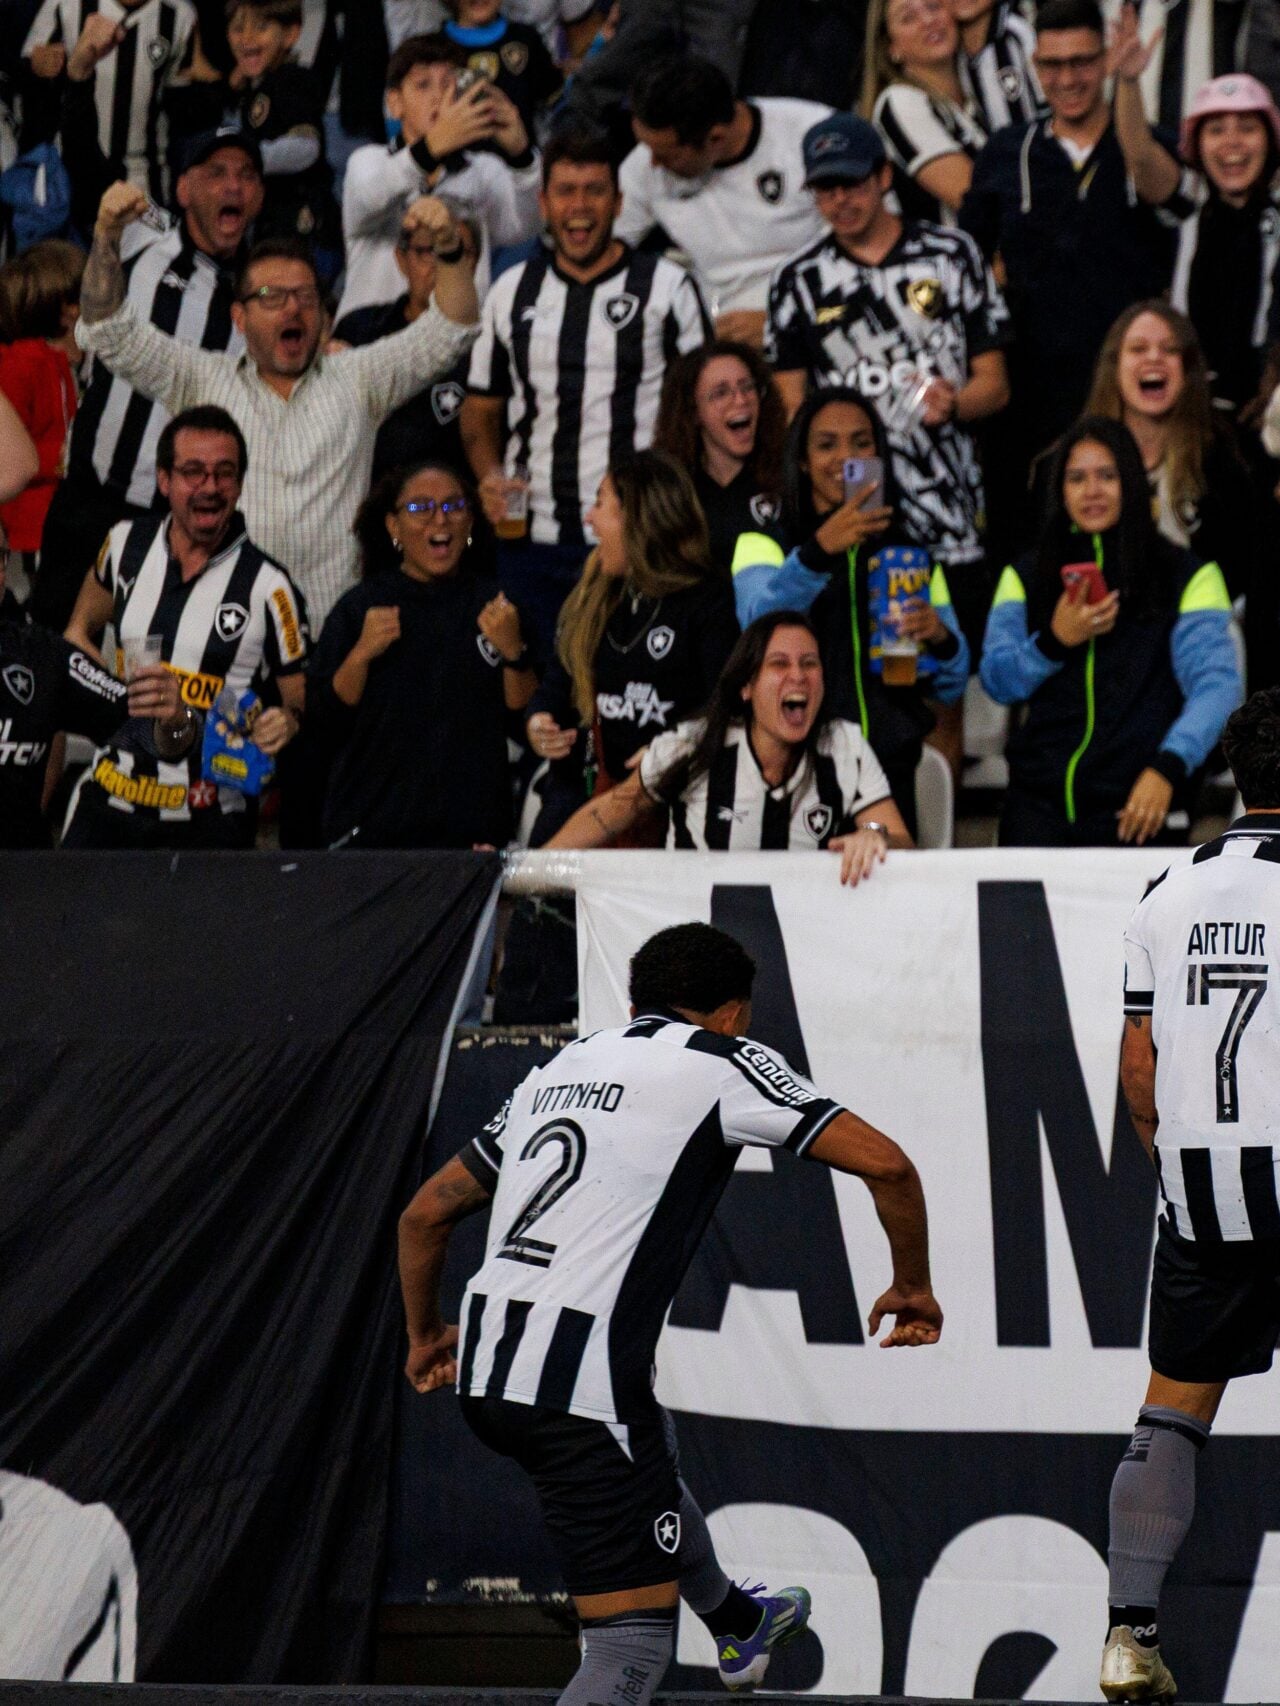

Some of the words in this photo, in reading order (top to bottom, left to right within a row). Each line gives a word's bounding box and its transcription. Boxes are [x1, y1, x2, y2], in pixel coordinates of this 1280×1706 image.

[1186, 921, 1266, 957] ARTUR
[1185, 963, 1269, 1124] 17
[530, 1082, 625, 1116] VITINHO
[740, 1044, 817, 1106] Centrum
[495, 1116, 587, 1268] 2
